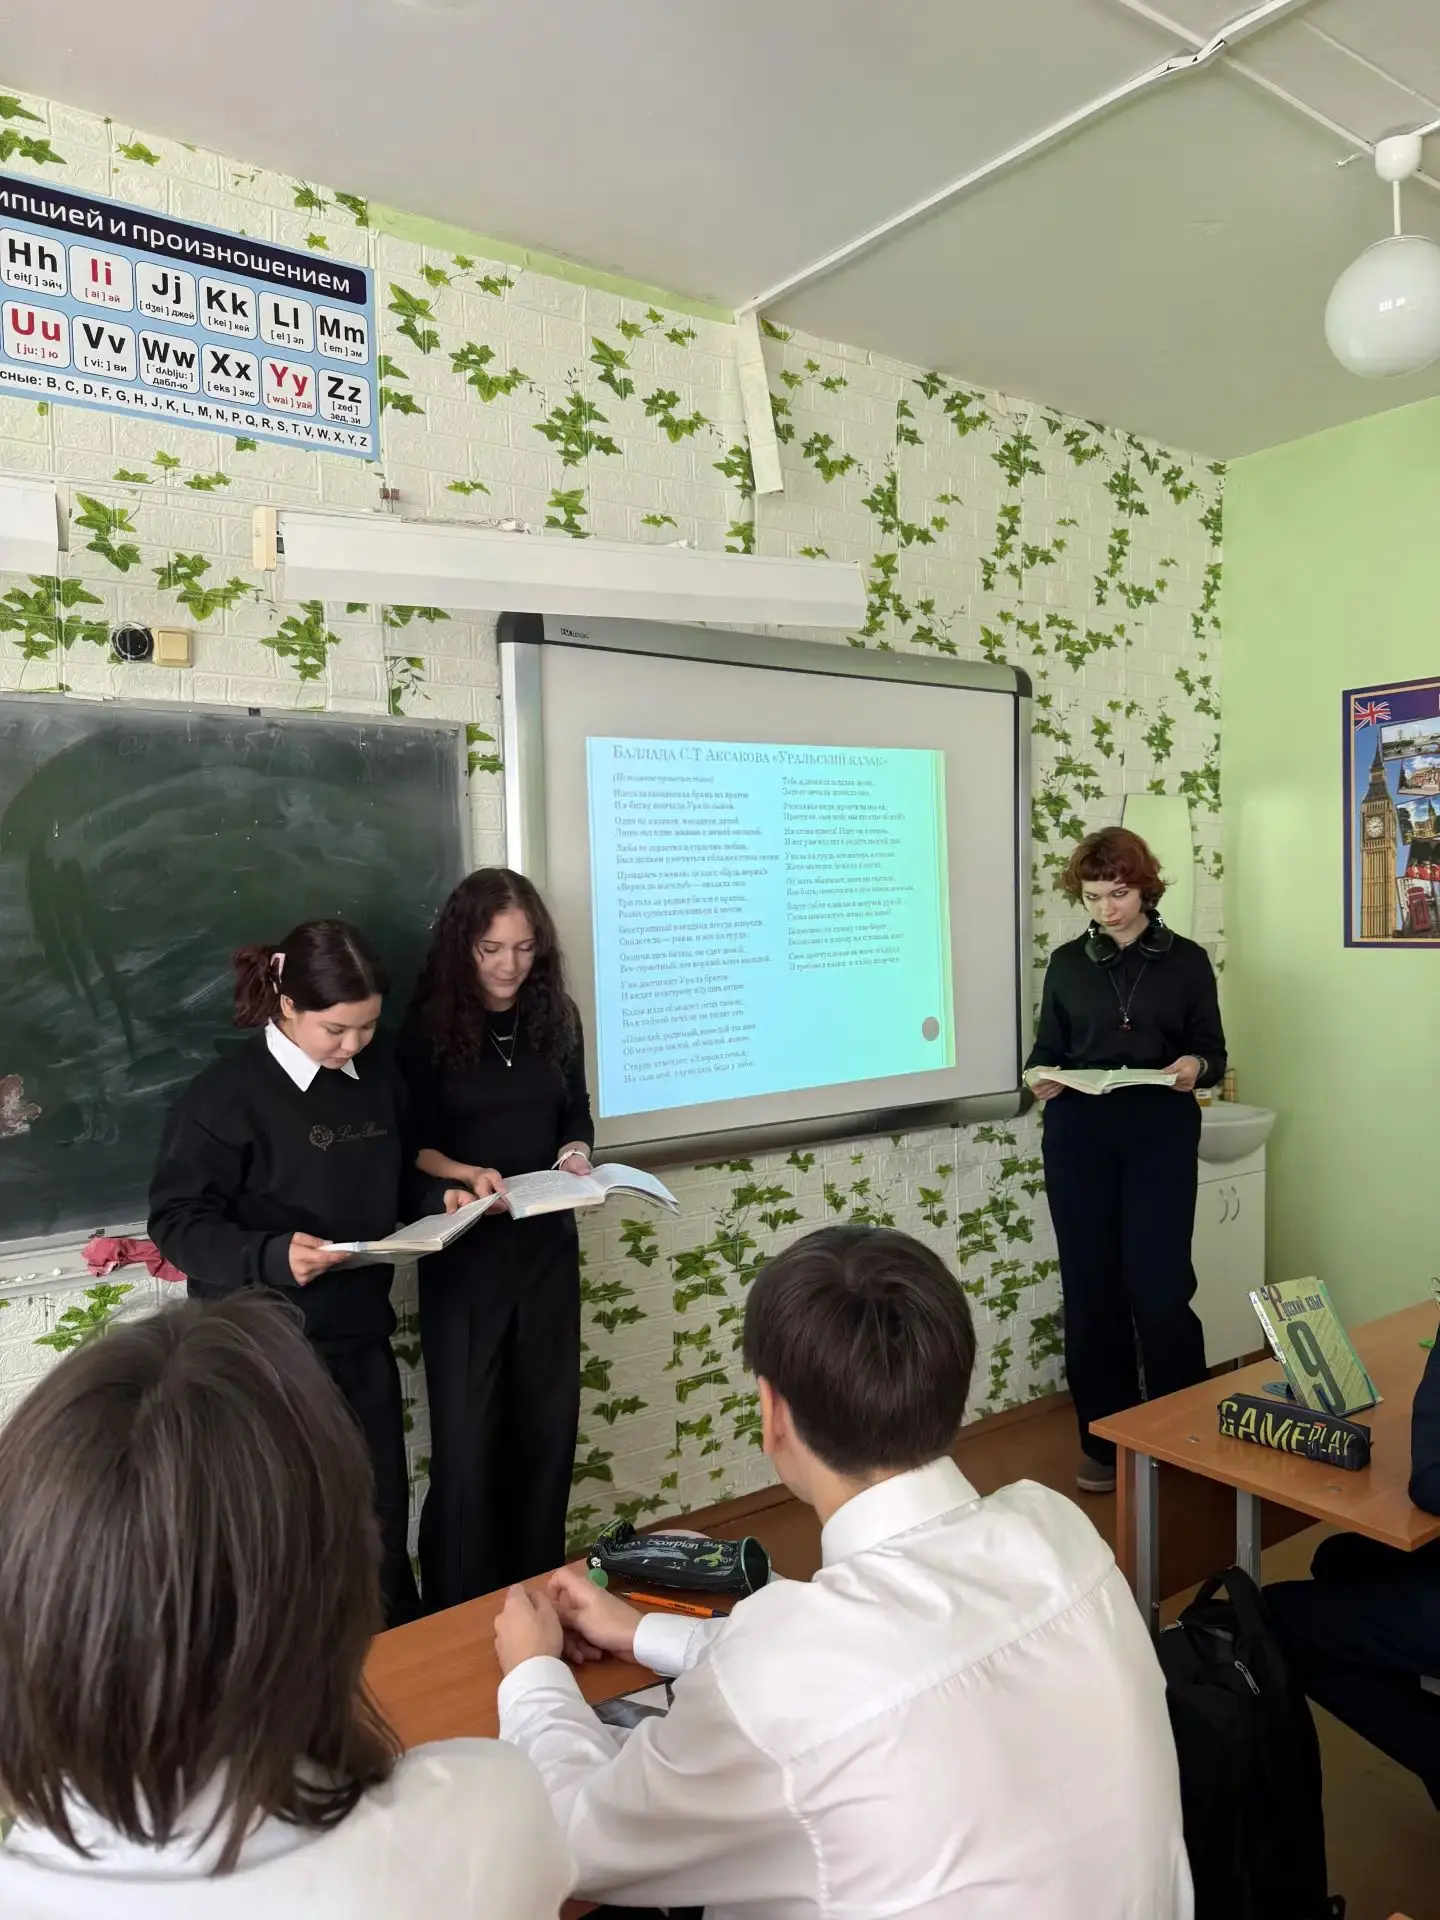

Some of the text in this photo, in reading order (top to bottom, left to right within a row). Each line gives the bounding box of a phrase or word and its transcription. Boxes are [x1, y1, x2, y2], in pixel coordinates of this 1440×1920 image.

[110, 218, 127, 237] и
[132, 224, 350, 294] произношением
[42, 279, 62, 290] эйч
[108, 294, 120, 303] ай
[172, 309, 195, 321] джей
[234, 323, 250, 333] кей
[293, 337, 304, 345] эл
[49, 351, 59, 359] ю
[351, 349, 363, 358] эм
[114, 364, 127, 373] ви
[239, 388, 256, 399] экс
[296, 400, 313, 410] уай
[359, 437, 368, 447] Z
[1286, 1320, 1347, 1415] 9
